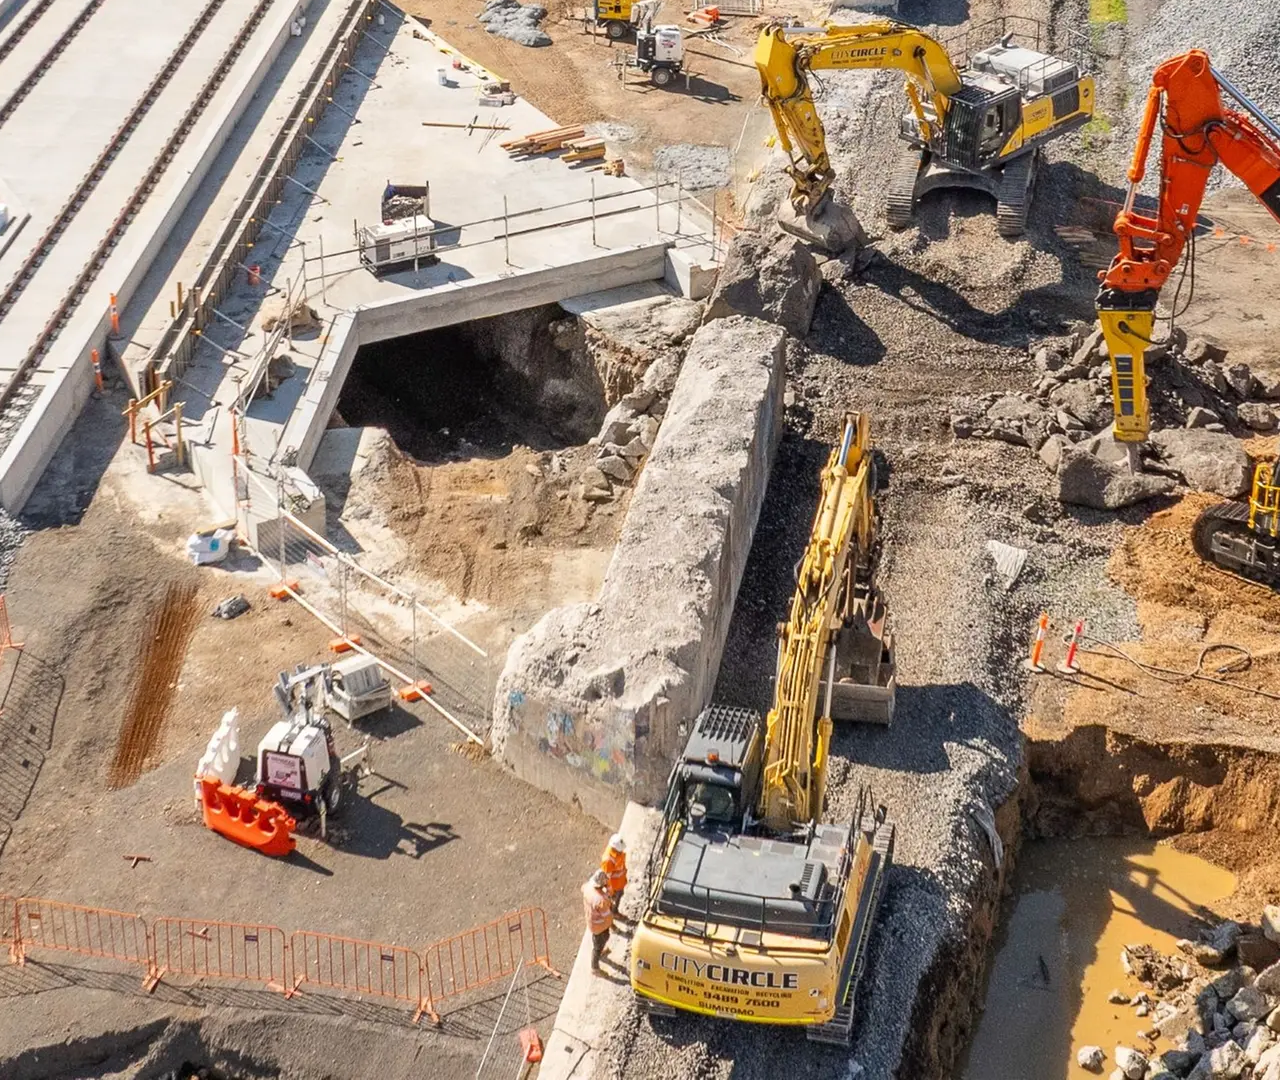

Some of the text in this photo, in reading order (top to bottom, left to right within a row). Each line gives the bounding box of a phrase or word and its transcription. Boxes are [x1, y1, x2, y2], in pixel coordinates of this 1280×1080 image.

[660, 951, 798, 989] CITYCIRCLE
[678, 985, 698, 996] Ph.
[711, 984, 749, 996] EXCAVATION
[755, 991, 792, 999] RECYCLING
